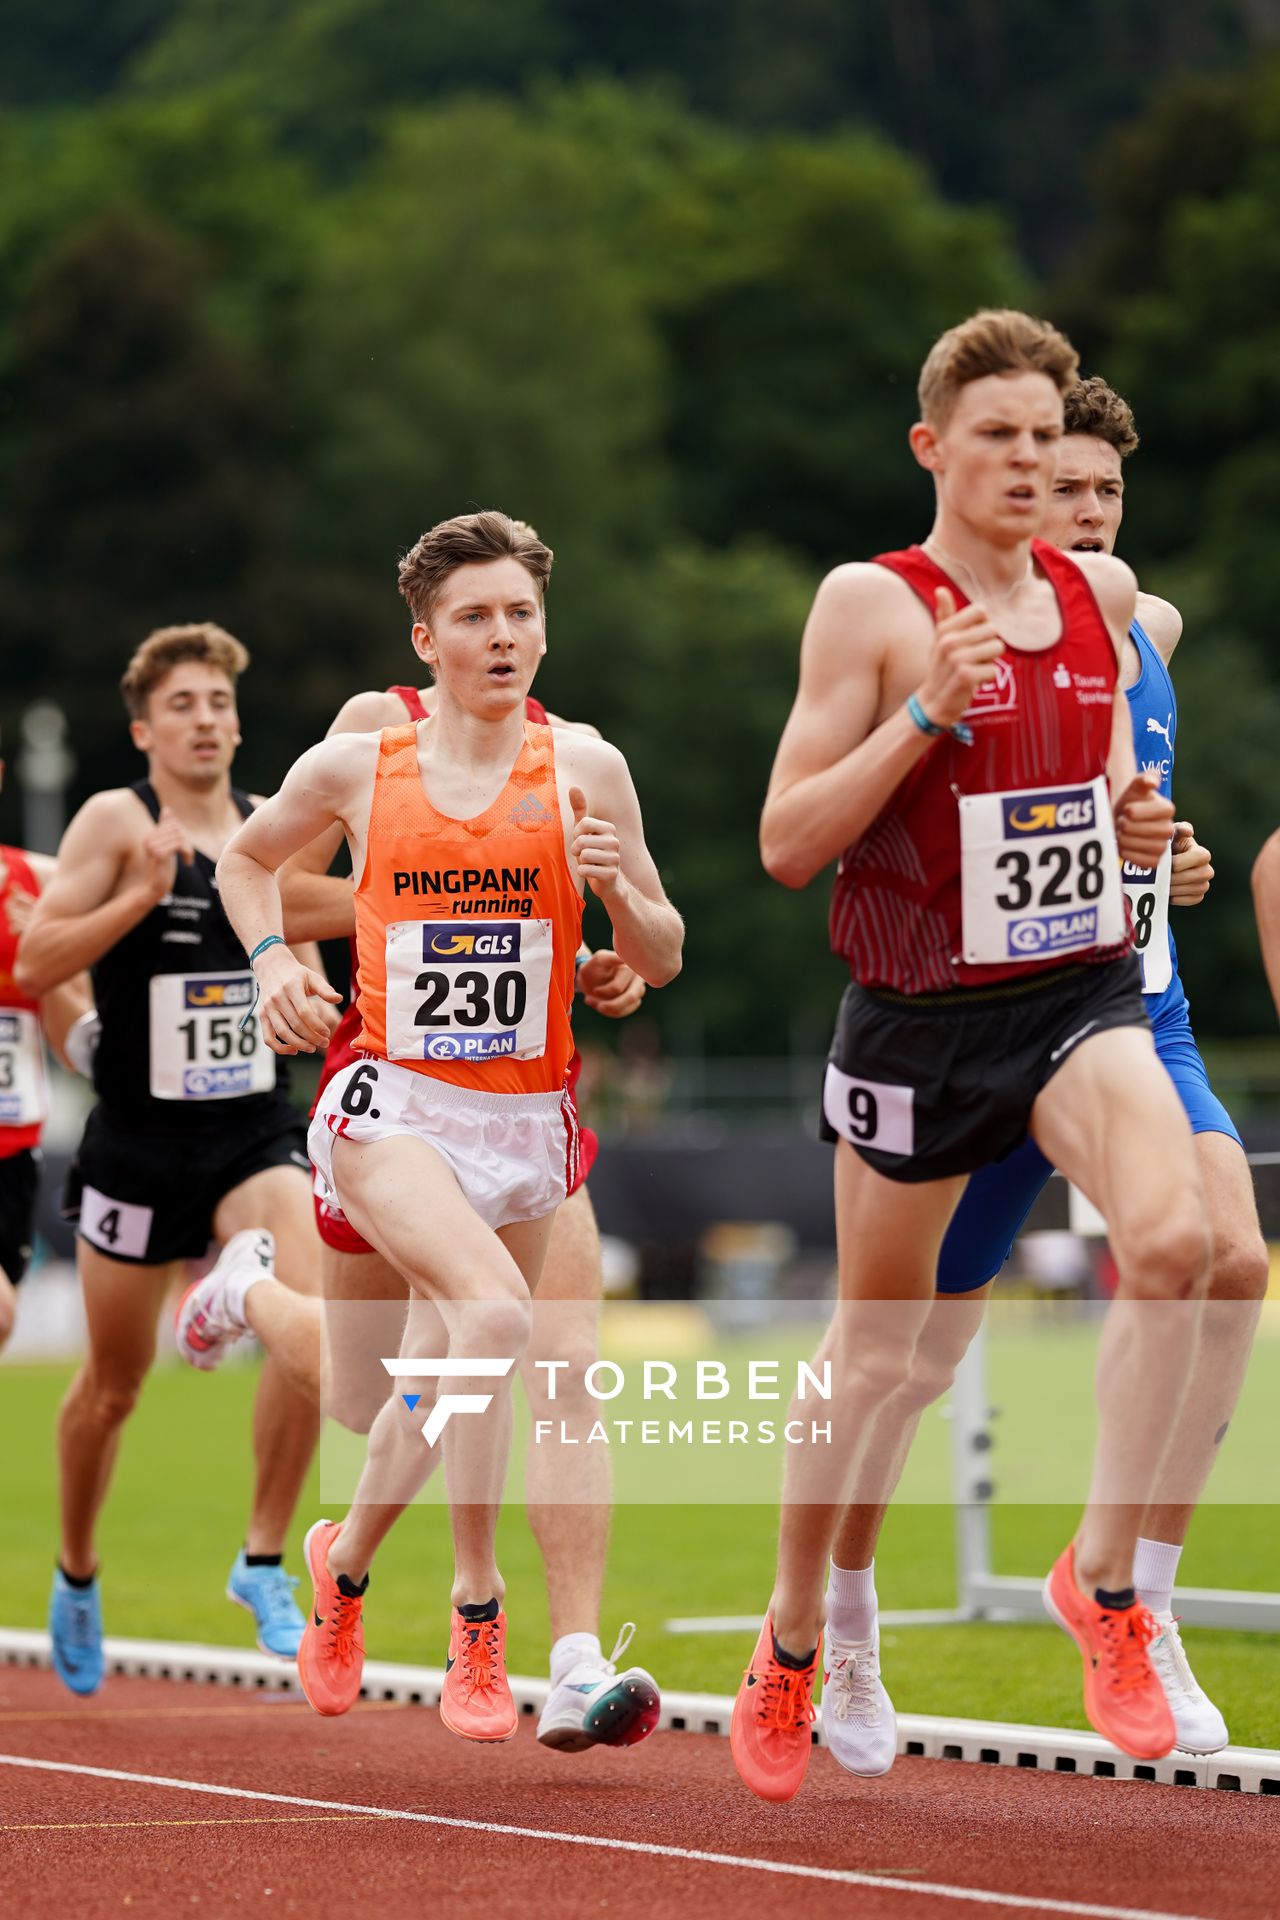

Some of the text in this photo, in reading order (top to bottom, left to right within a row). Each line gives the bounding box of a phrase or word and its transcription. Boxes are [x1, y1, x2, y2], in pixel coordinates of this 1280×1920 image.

[1056, 798, 1093, 827] GLS
[393, 868, 540, 896] PINGPANK
[994, 840, 1105, 911] 328
[452, 894, 533, 917] running
[1124, 891, 1156, 949] 8
[1048, 912, 1095, 940] PLAN
[474, 935, 513, 955] GLS
[414, 970, 527, 1028] 230
[177, 1015, 257, 1061] 158
[464, 1037, 513, 1054] PLAN
[340, 1064, 380, 1119] 6.
[848, 1087, 877, 1140] 9
[98, 1209, 119, 1244] 4
